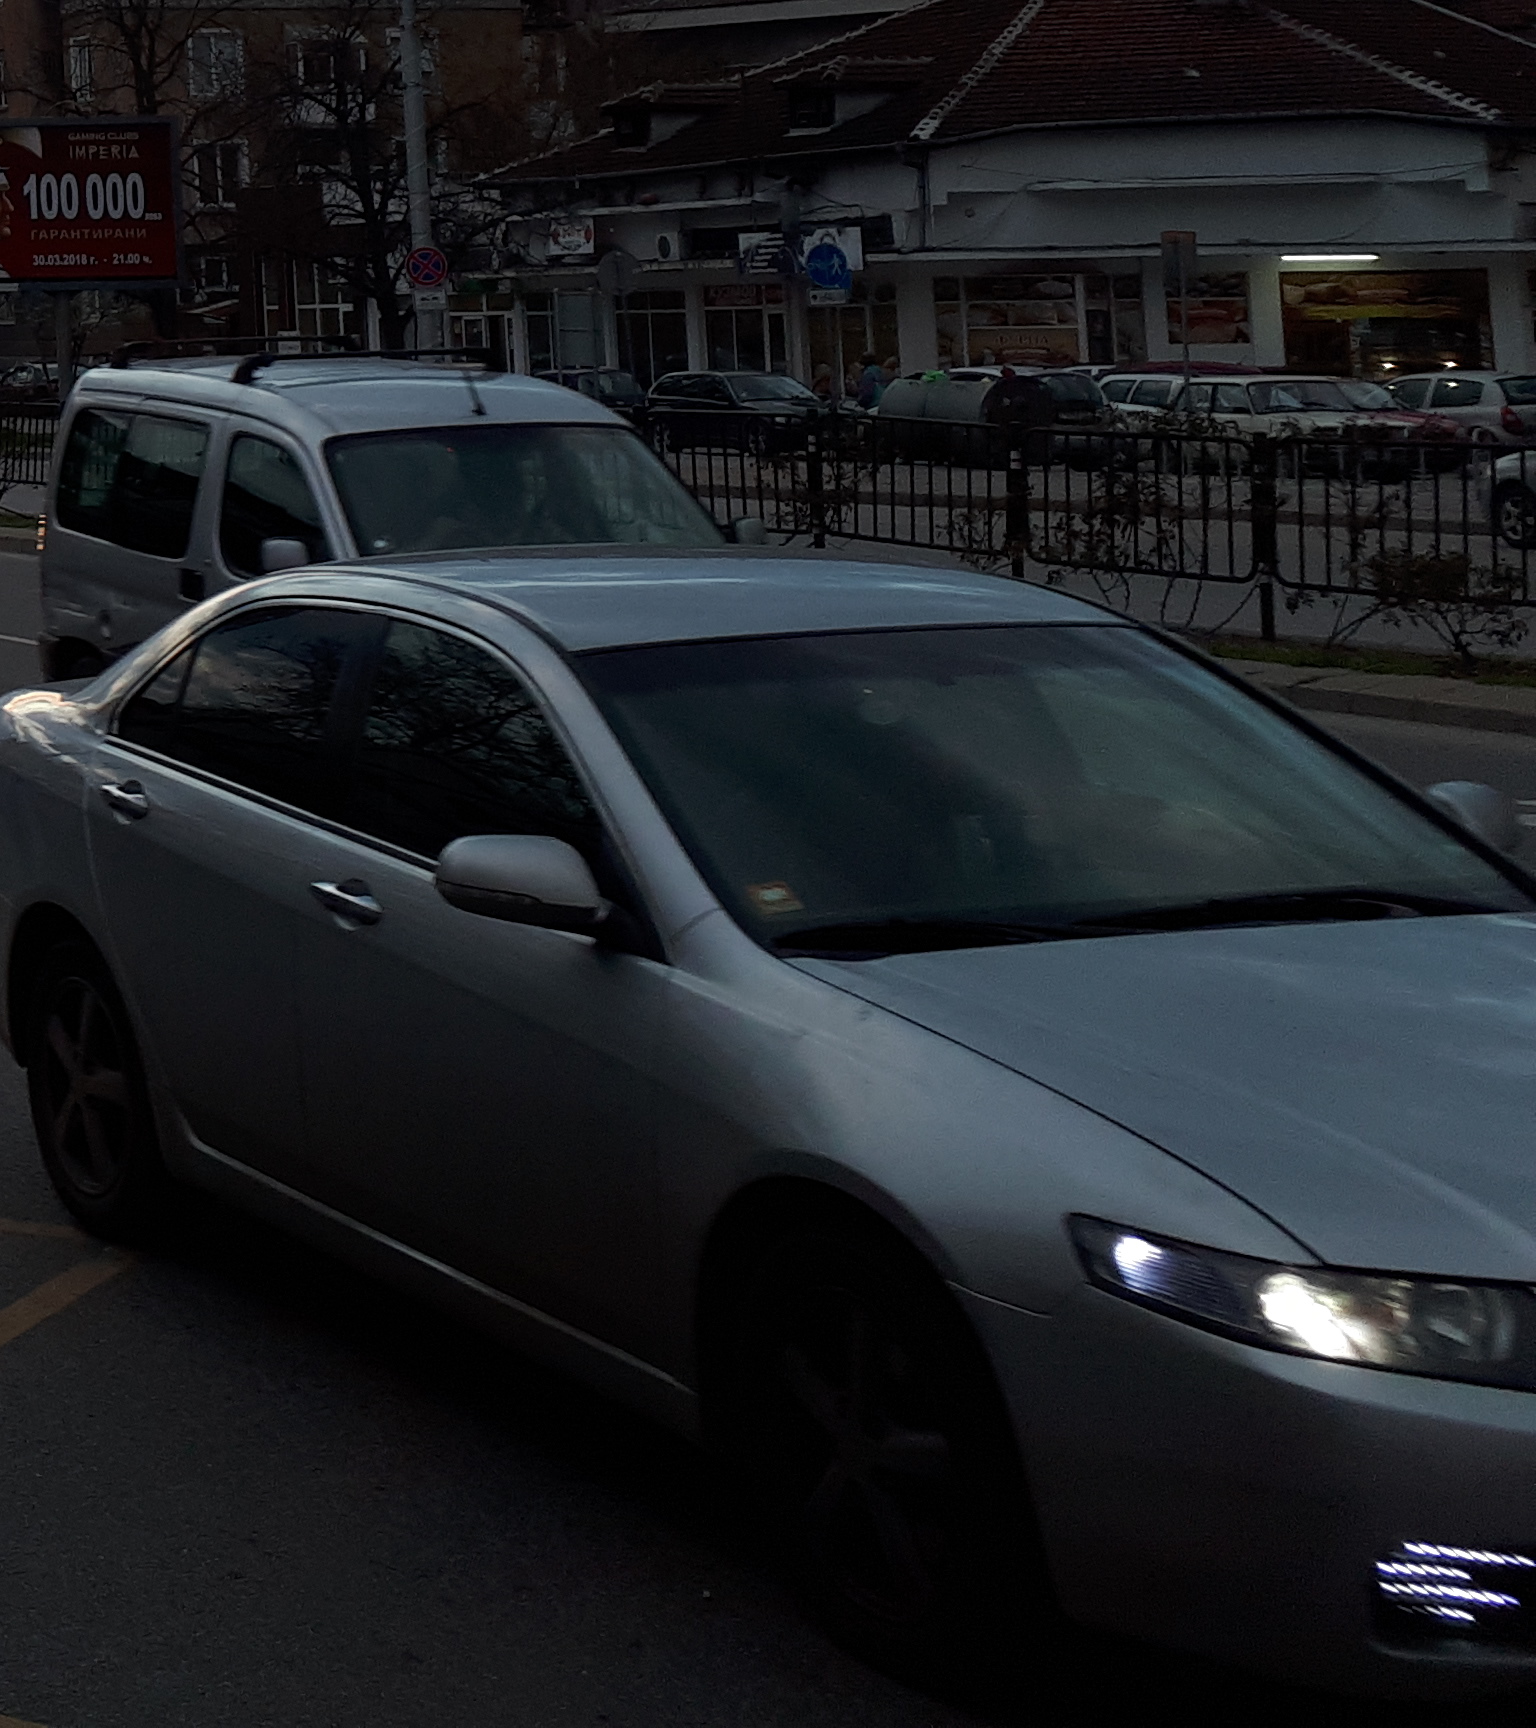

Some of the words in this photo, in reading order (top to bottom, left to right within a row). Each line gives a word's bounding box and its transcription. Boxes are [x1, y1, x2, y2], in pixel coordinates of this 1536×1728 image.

[69, 144, 140, 161] IMPERIA
[22, 172, 79, 221] 100
[85, 172, 145, 221] 000
[30, 227, 147, 241] ГАРАНТИРАНИ
[32, 253, 88, 266] 30.03.2018
